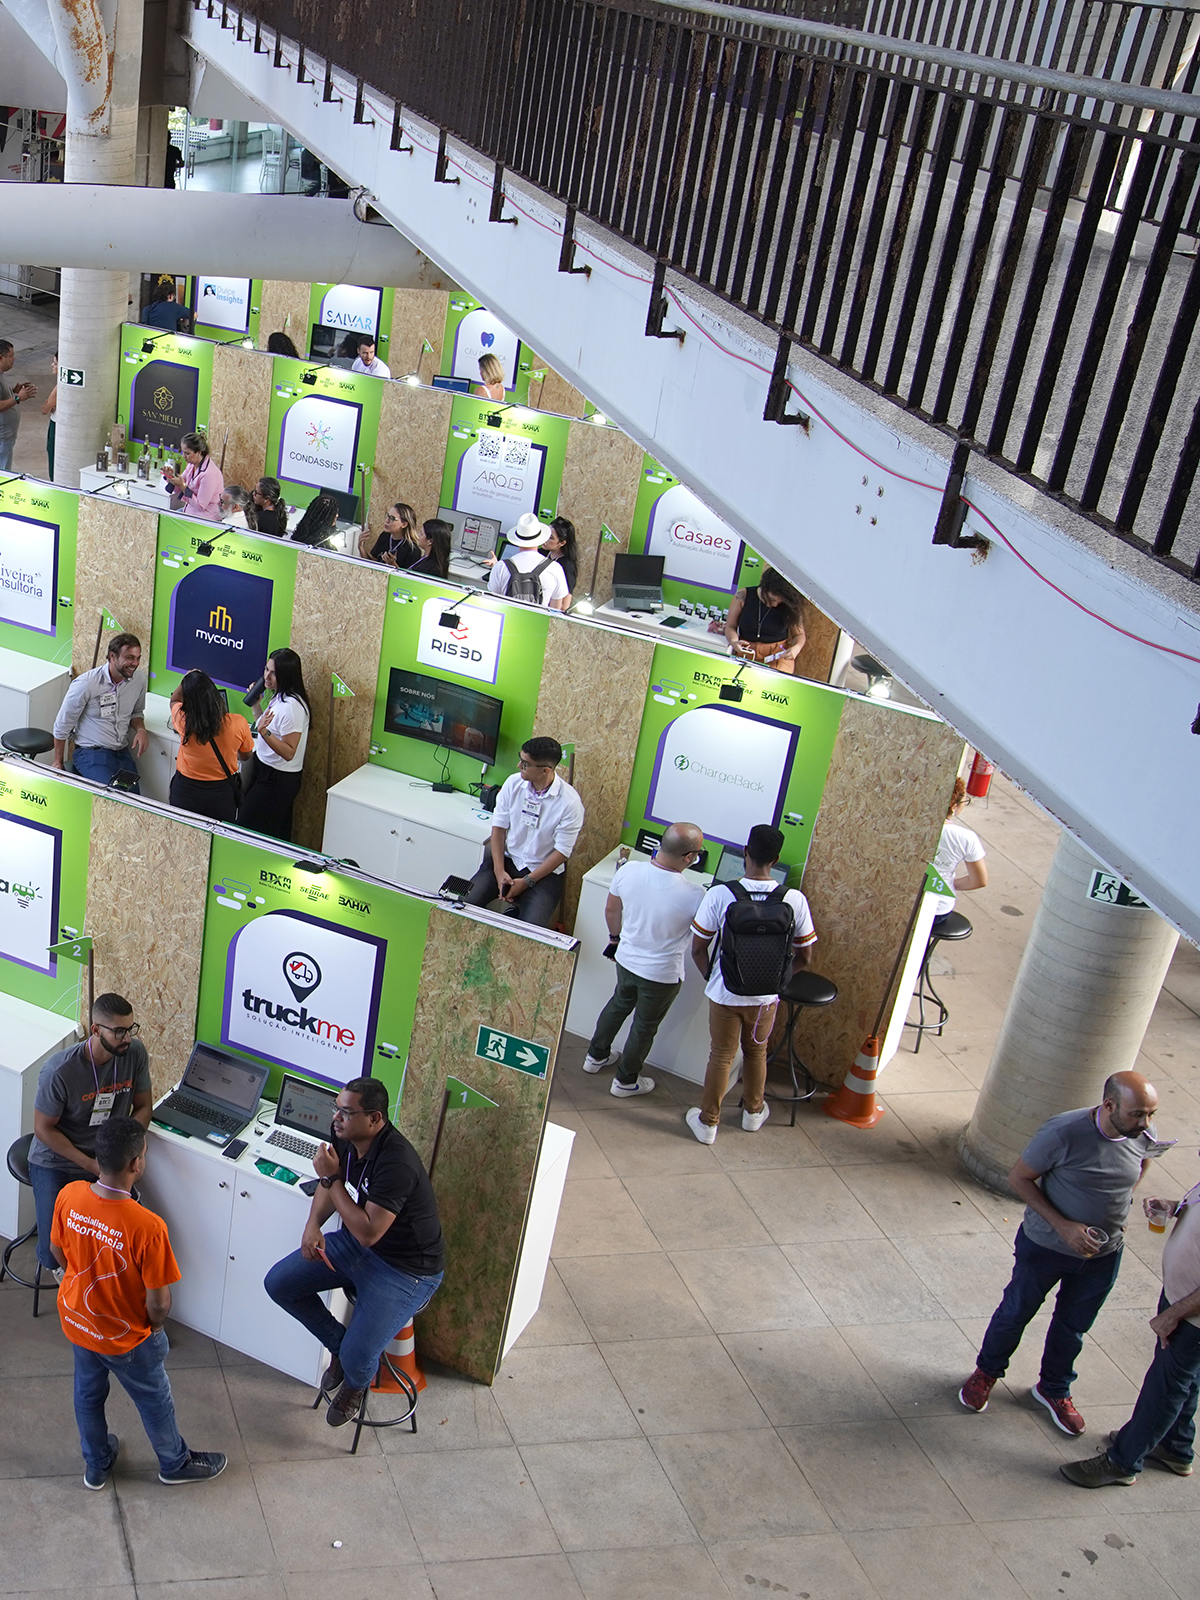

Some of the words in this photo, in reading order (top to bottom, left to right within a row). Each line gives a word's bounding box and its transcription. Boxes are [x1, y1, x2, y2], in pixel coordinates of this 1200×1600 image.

[216, 285, 236, 295] Dulce
[216, 293, 244, 305] Insights
[326, 309, 372, 331] SALVAR
[533, 371, 544, 379] 33
[289, 450, 344, 471] CONDASSIST
[603, 530, 613, 541] 24
[674, 524, 732, 551] Casaes
[106, 616, 115, 629] 16
[195, 629, 244, 651] mycond
[336, 682, 346, 695] 15
[400, 686, 420, 697] SOBRE
[420, 691, 436, 700] NÓS
[760, 691, 789, 706] BAHIA
[690, 761, 765, 794] ChargeBack
[20, 790, 48, 807] BAHIA
[260, 869, 283, 887] BTX
[299, 885, 331, 901] SEBRAE
[338, 896, 371, 915] BAHIA
[931, 876, 945, 892] 13
[72, 944, 82, 957] 2
[241, 988, 356, 1047] truckme
[246, 1013, 287, 1032] SOLUÇÃO
[291, 1029, 348, 1054] INTELIGENTE
[460, 1091, 469, 1103] 1
[69, 1208, 109, 1233] Especialista
[109, 1228, 123, 1239] em
[66, 1217, 124, 1251] Recorrência
[64, 1315, 104, 1340] conexa.app
